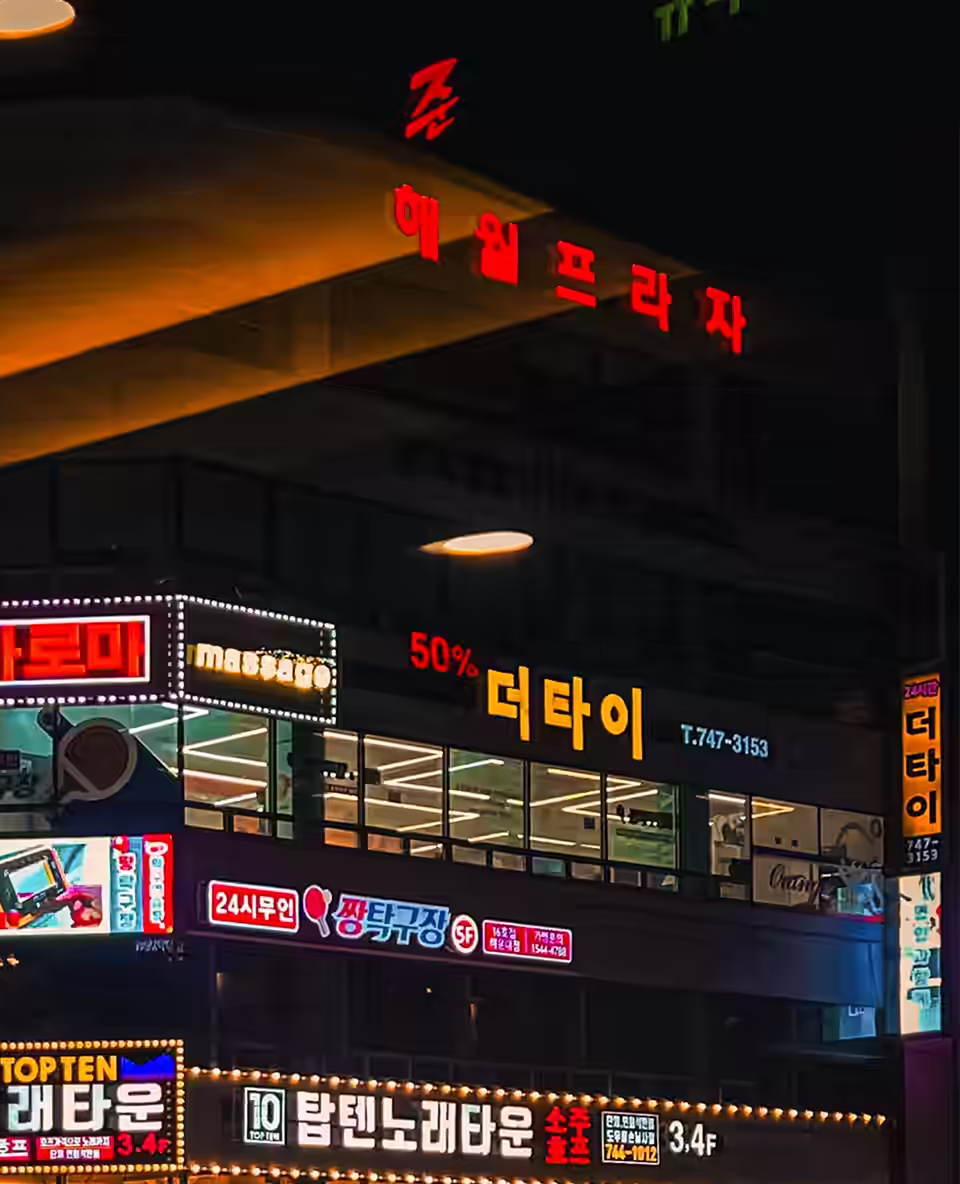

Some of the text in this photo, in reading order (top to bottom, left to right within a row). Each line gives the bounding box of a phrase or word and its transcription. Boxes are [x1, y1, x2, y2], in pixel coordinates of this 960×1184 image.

[411, 631, 479, 678] 50%
[487, 664, 643, 760] 더타이
[680, 722, 770, 758] T.747-3153
[905, 705, 940, 825] 더타이
[215, 889, 296, 925] 24시무인
[332, 892, 451, 949] 짱탁구장
[0, 1056, 57, 1084] TOP
[60, 1054, 118, 1082] TEN
[249, 1091, 281, 1131] 10
[296, 1090, 534, 1159] 탑텐노래타운
